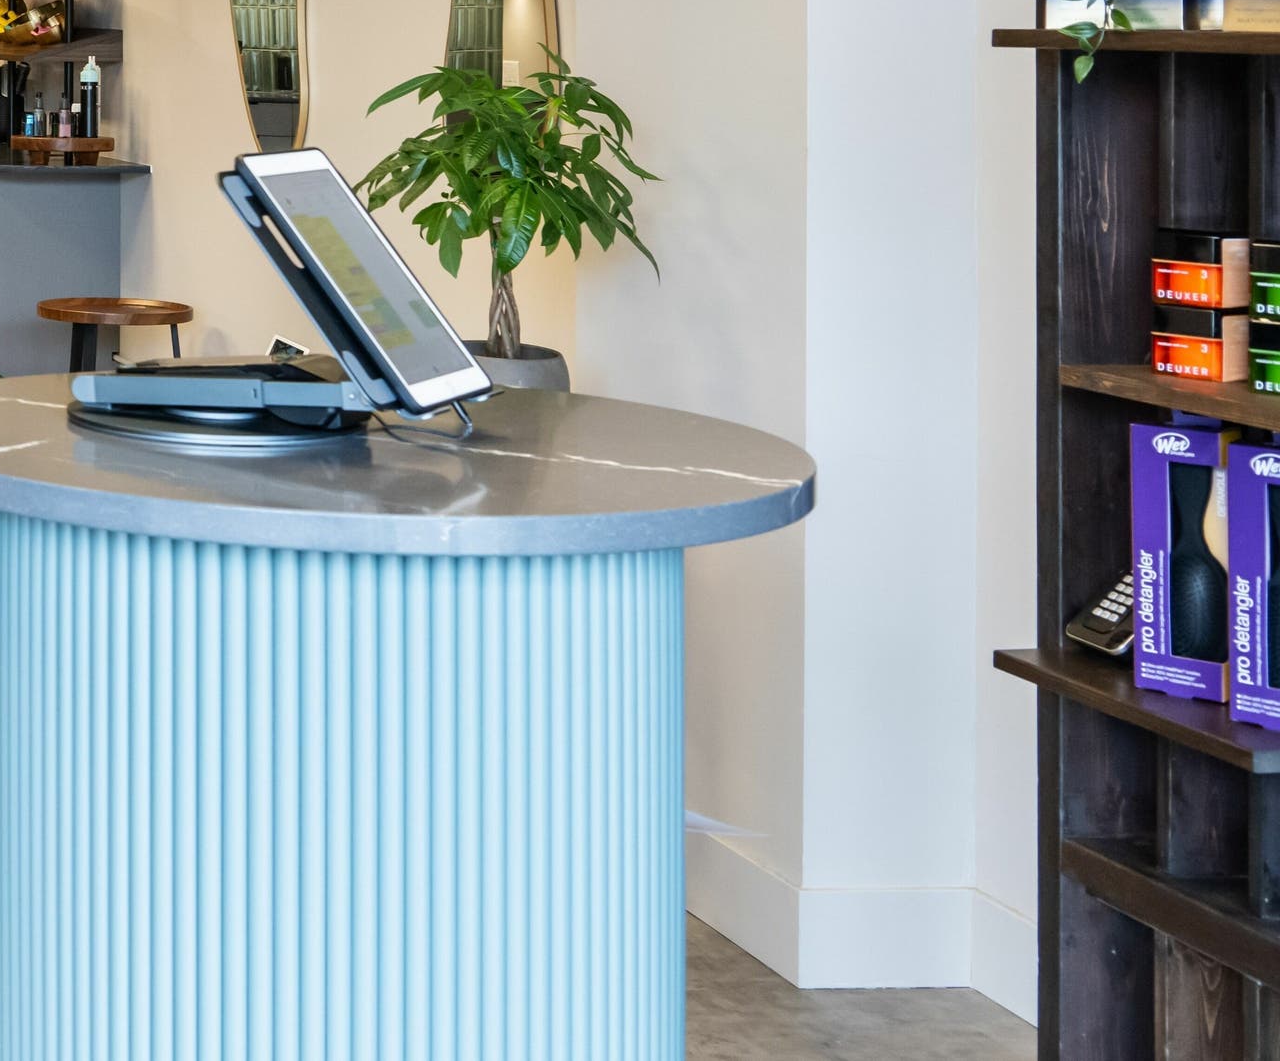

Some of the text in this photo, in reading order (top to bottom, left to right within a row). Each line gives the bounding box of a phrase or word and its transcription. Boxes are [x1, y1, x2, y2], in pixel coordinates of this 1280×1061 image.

[1201, 269, 1208, 280] 3
[1157, 289, 1208, 302] DEUXER
[1201, 343, 1208, 354] 3
[1157, 362, 1209, 376] DEUXER
[1157, 436, 1187, 454] Wet
[1254, 457, 1280, 476] We
[1137, 548, 1159, 655] pro detangler
[1233, 575, 1255, 686] pro detangler
